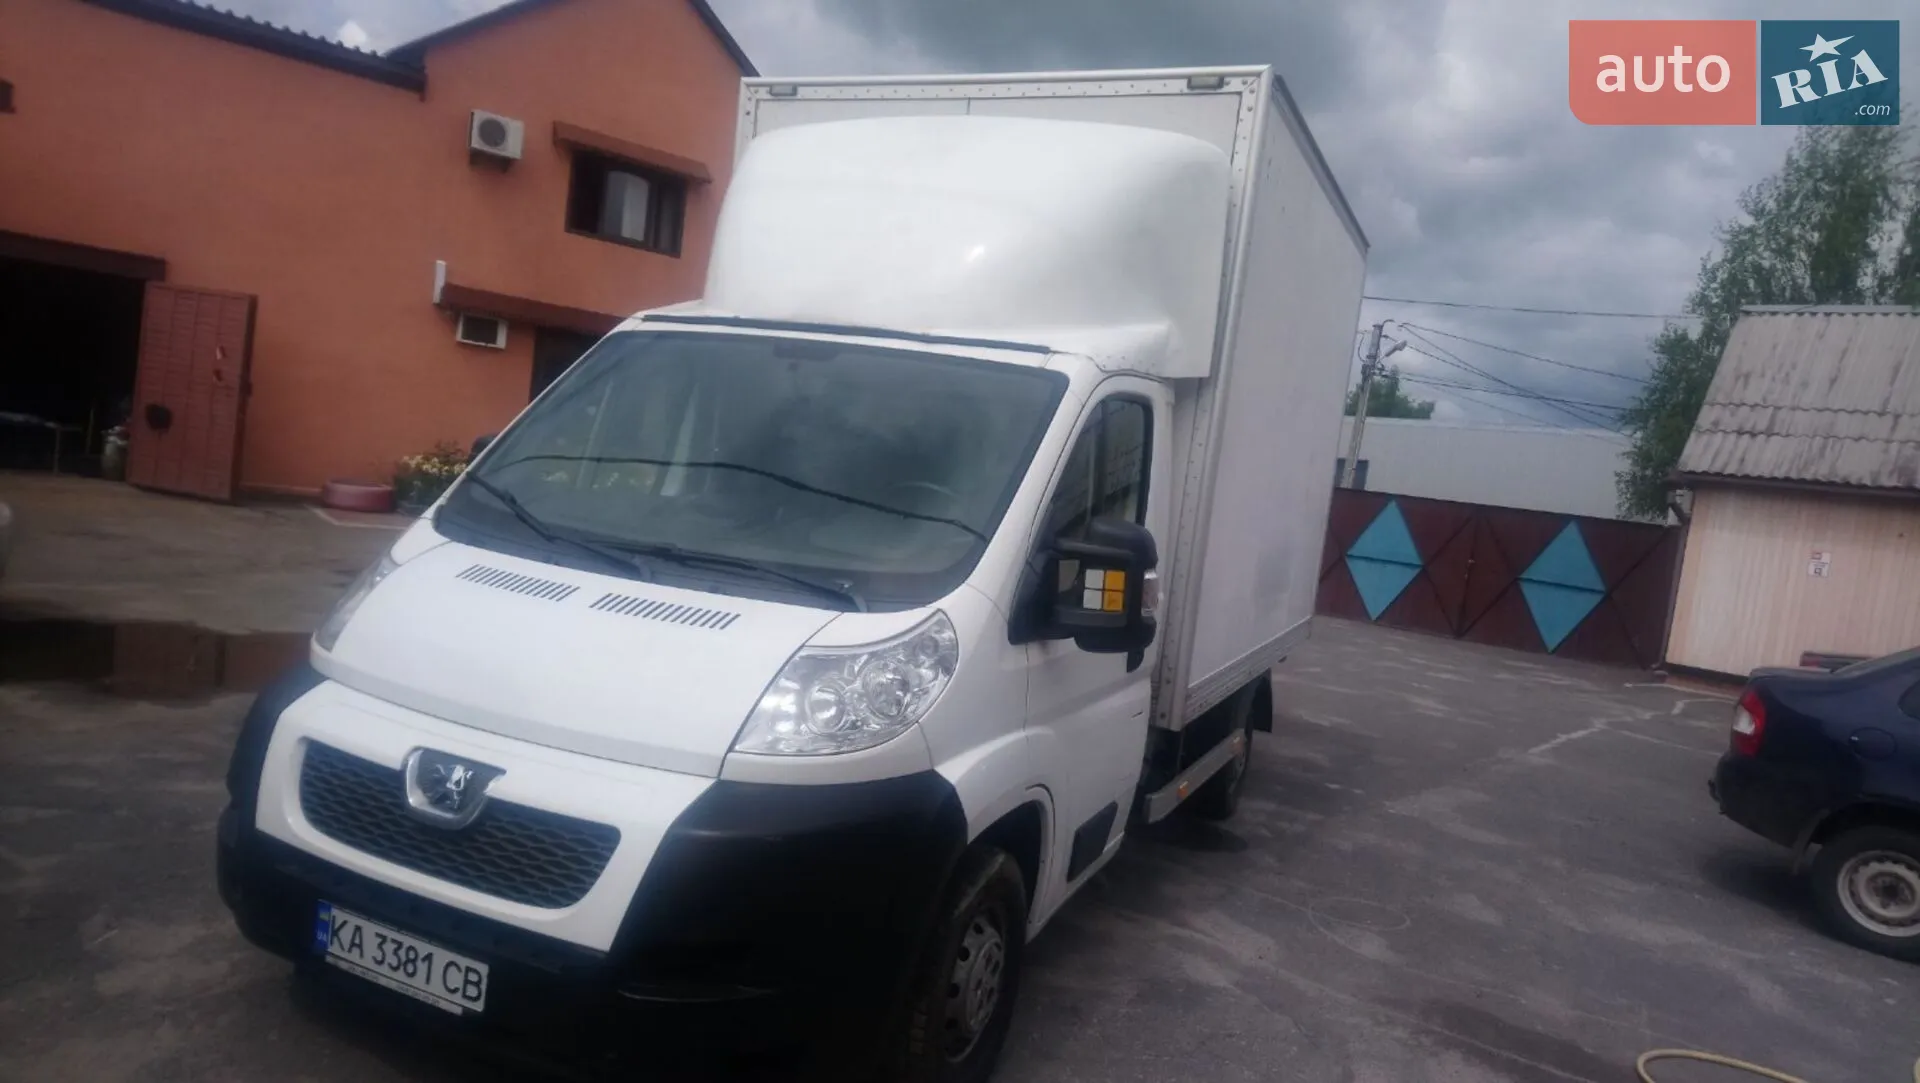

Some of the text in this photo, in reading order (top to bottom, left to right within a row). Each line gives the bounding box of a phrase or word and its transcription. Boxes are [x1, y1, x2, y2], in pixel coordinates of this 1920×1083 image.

[329, 914, 364, 959] KA
[371, 931, 434, 985] 3381
[442, 960, 482, 1003] CB
